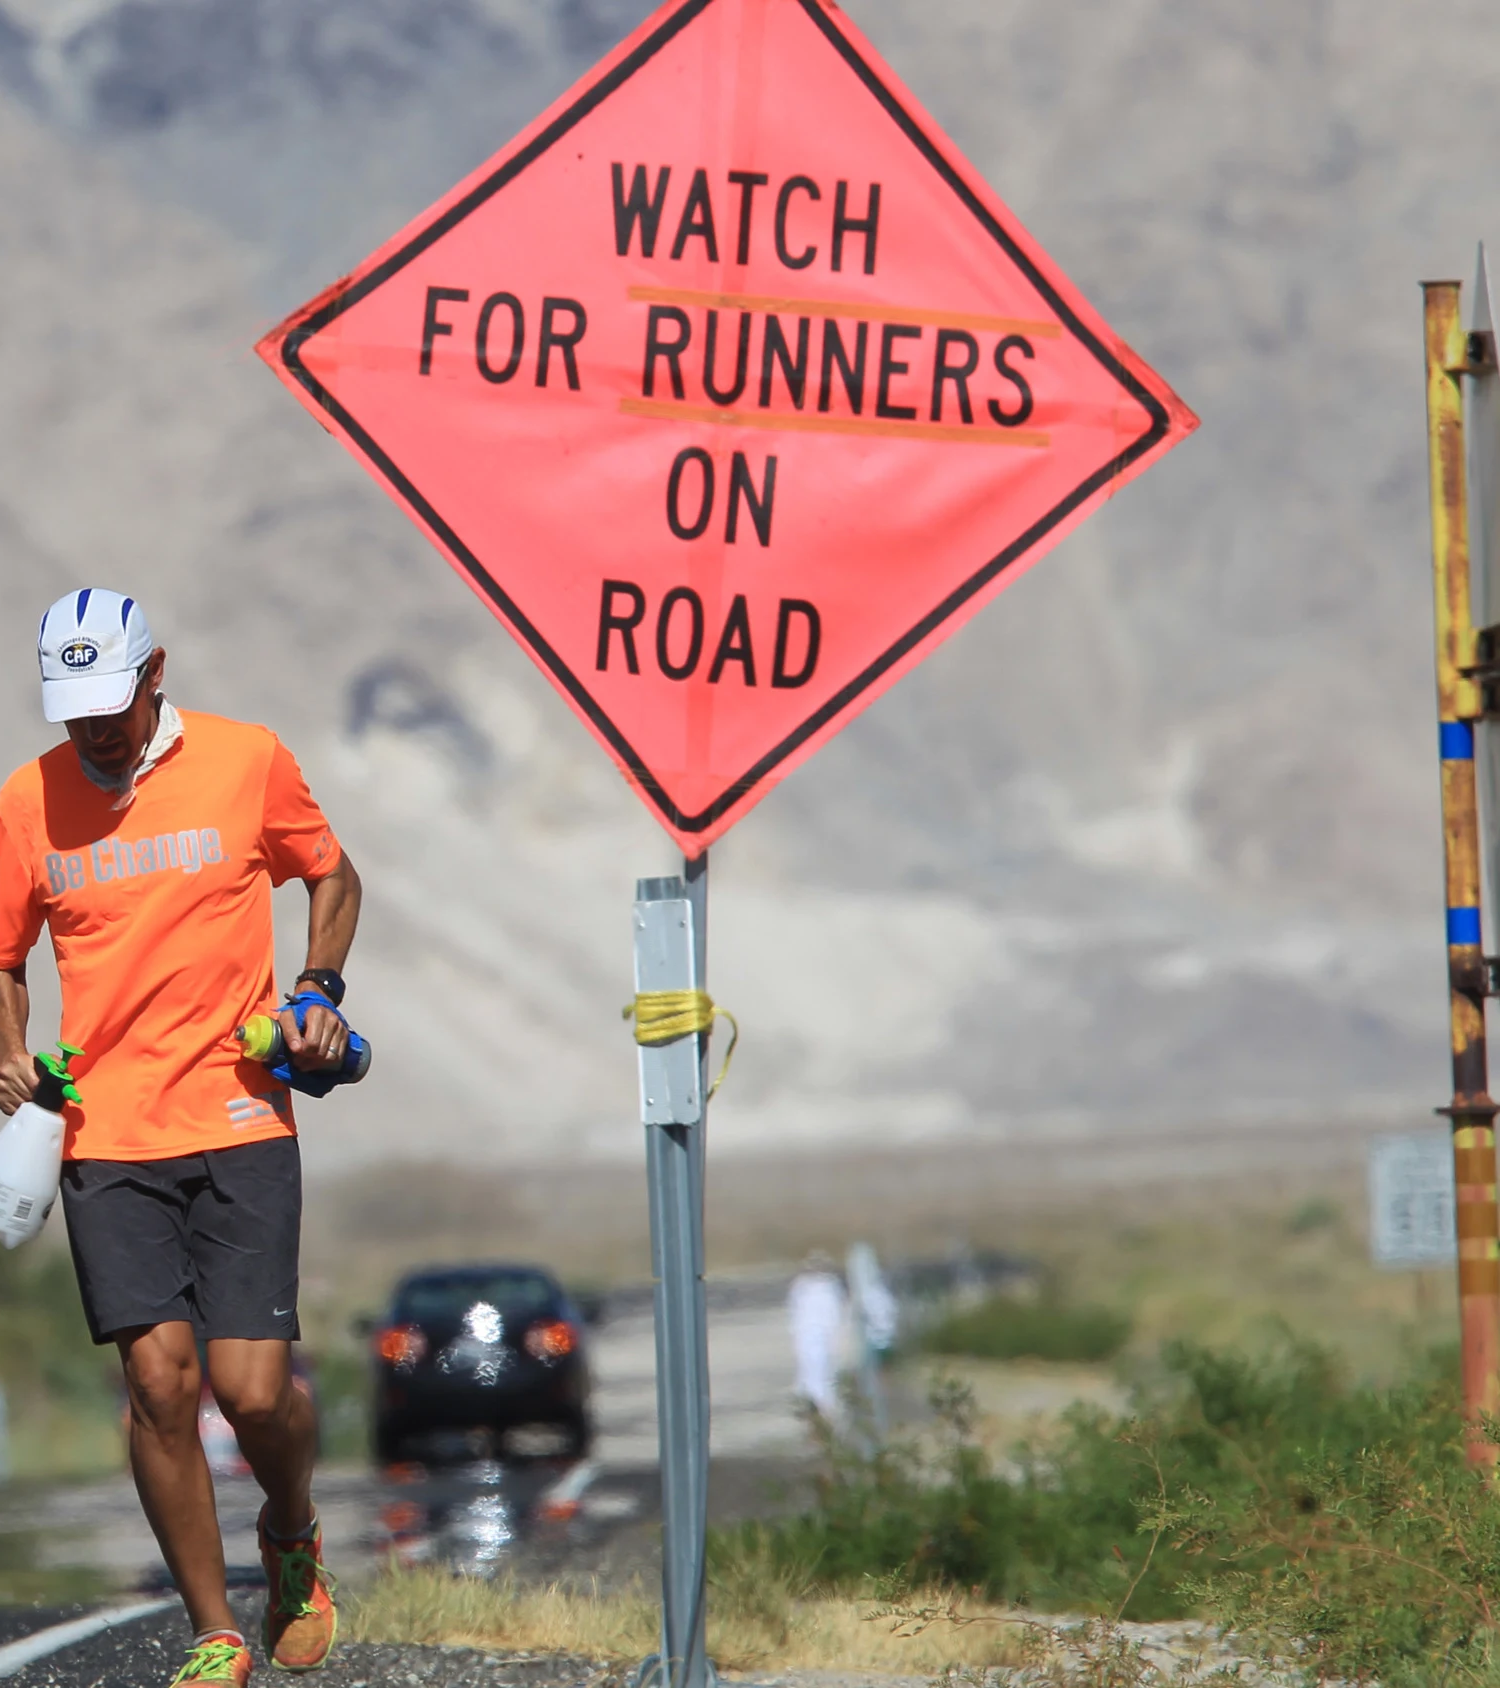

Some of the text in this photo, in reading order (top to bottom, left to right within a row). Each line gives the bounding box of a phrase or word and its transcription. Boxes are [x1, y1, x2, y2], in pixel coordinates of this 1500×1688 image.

[612, 163, 880, 275] WATCH
[420, 286, 1034, 427] FOR RUNNERS
[666, 447, 777, 547] ON
[64, 649, 93, 664] CAF
[596, 579, 821, 689] ROAD
[45, 828, 230, 896] Be Change.
